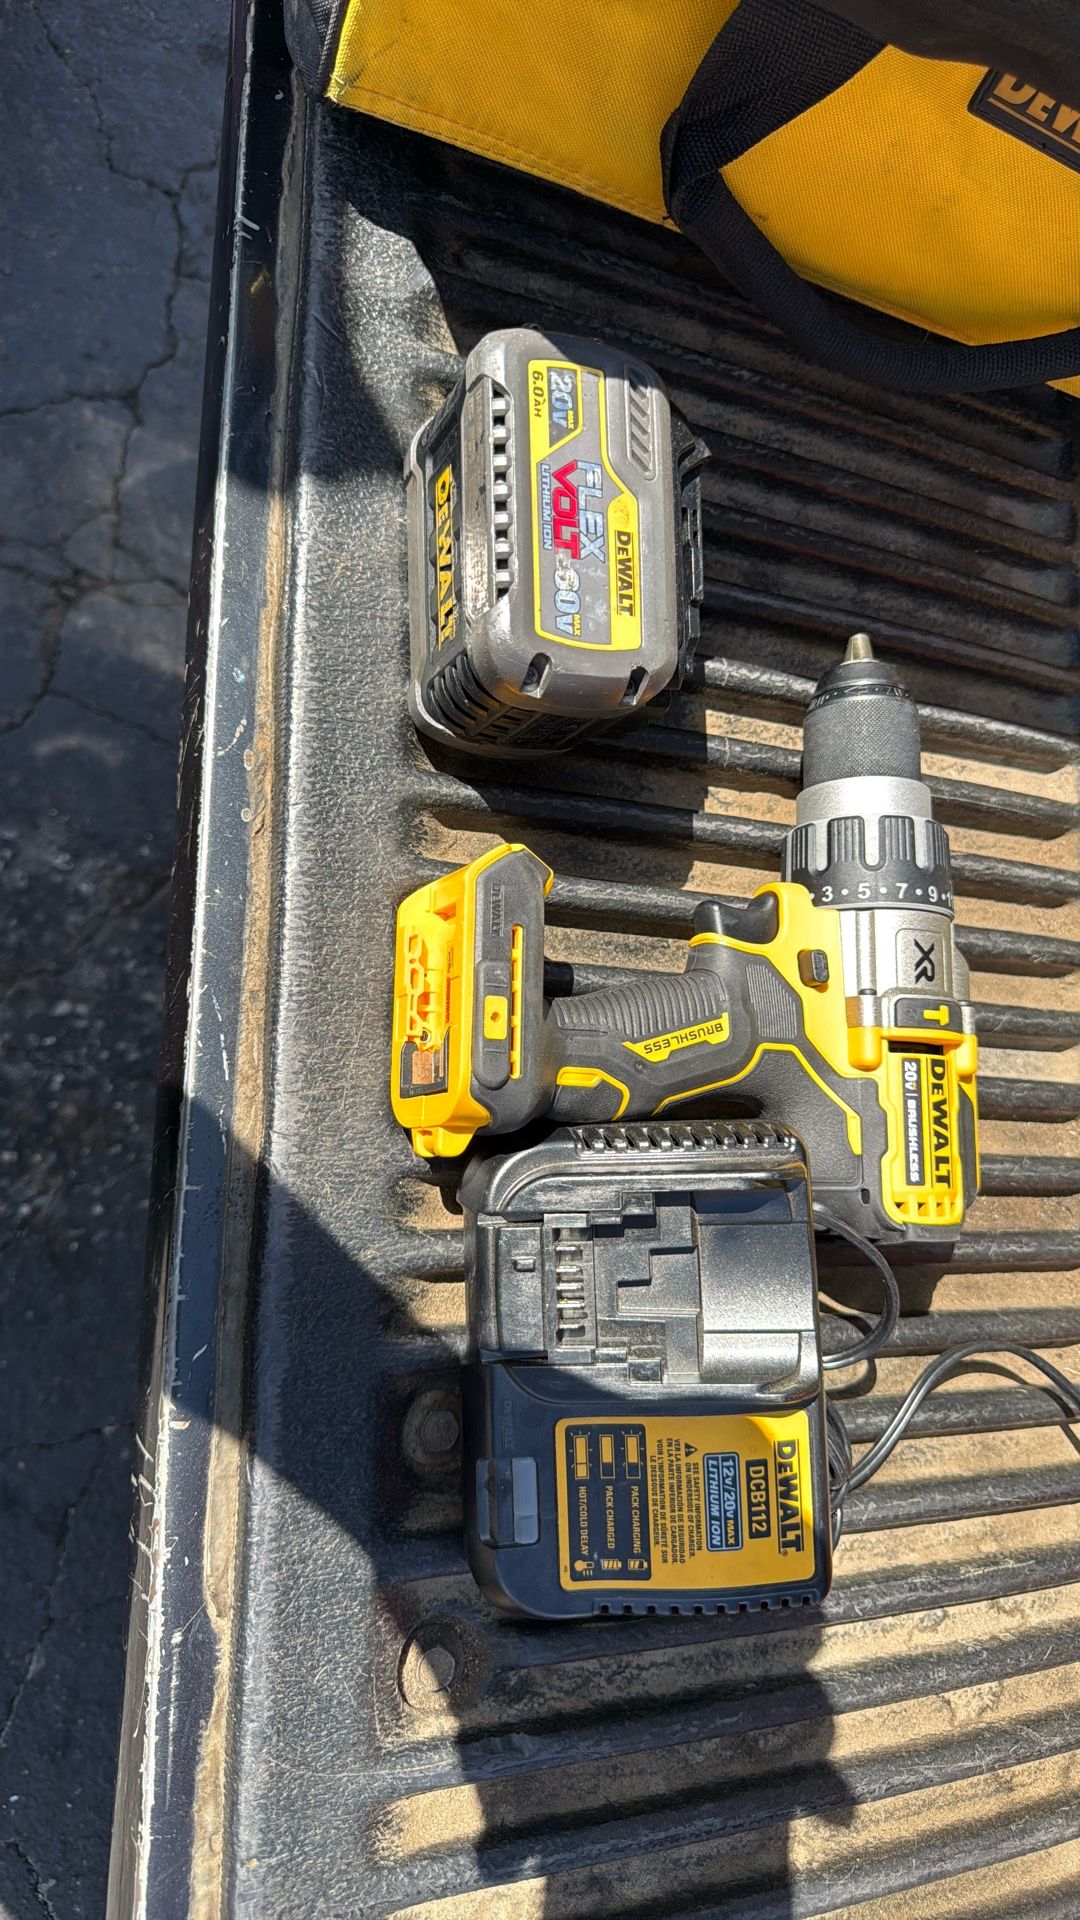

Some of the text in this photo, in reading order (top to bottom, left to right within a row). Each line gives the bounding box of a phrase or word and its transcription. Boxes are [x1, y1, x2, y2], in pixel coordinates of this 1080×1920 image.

[541, 464, 553, 550] LITHIUM ION
[551, 460, 580, 560] VOLT
[578, 461, 605, 563] FLEX
[573, 614, 581, 636] MAX
[821, 885, 834, 902] 3
[857, 883, 871, 899] 5
[895, 883, 909, 899] 7
[928, 885, 938, 902] 9
[914, 938, 935, 985] XR
[644, 1022, 724, 1054] BRUSHLESS
[908, 1100, 919, 1182] BRUSHLESS
[931, 1059, 950, 1188] DEWALT
[667, 1438, 673, 1447] EN
[668, 1449, 673, 1457] LA
[578, 1486, 588, 1527] HOT/COLD
[652, 1498, 658, 1507] DE
[675, 1453, 681, 1462] LA
[678, 1514, 683, 1523] DE
[685, 1463, 691, 1472] ON
[688, 1515, 693, 1523] OF
[708, 1460, 720, 1546] LITHIUM ION
[749, 1466, 767, 1533] DCB112
[605, 1486, 615, 1549] PACK CHARGED
[631, 1486, 641, 1553] PACK CHARGING
[660, 1512, 666, 1520] DE
[670, 1515, 676, 1523] DE
[694, 1504, 702, 1551] INFORMATION
